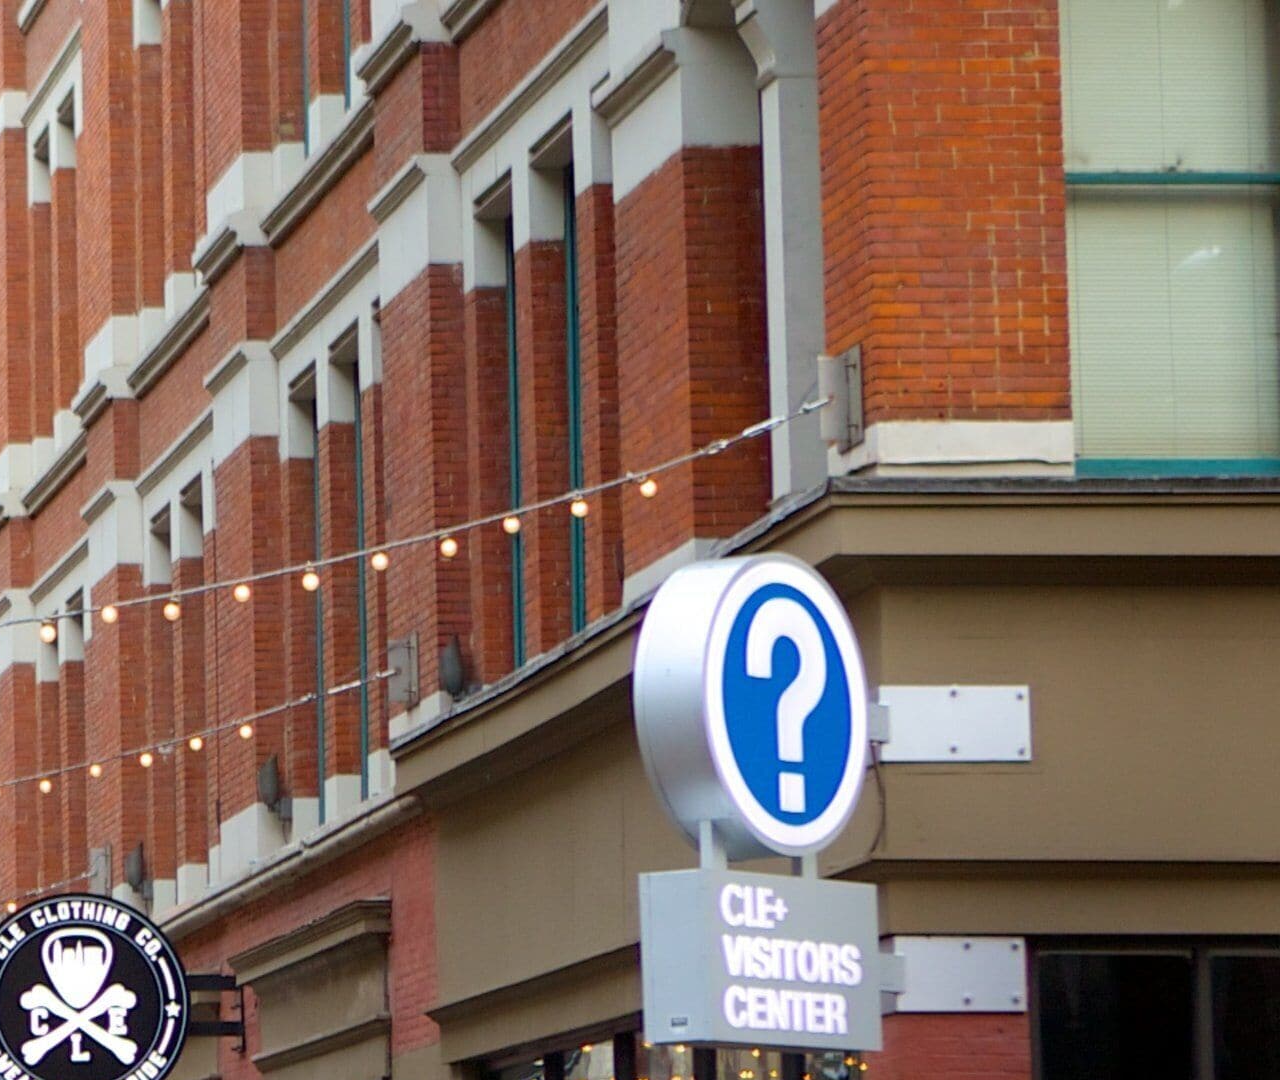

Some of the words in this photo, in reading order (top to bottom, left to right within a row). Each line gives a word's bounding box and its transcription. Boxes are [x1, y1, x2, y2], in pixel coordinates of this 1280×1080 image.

[30, 900, 132, 932] CLOTHING
[134, 930, 160, 963] CO.
[721, 934, 863, 986] VISITORS
[723, 986, 849, 1035] CENTER
